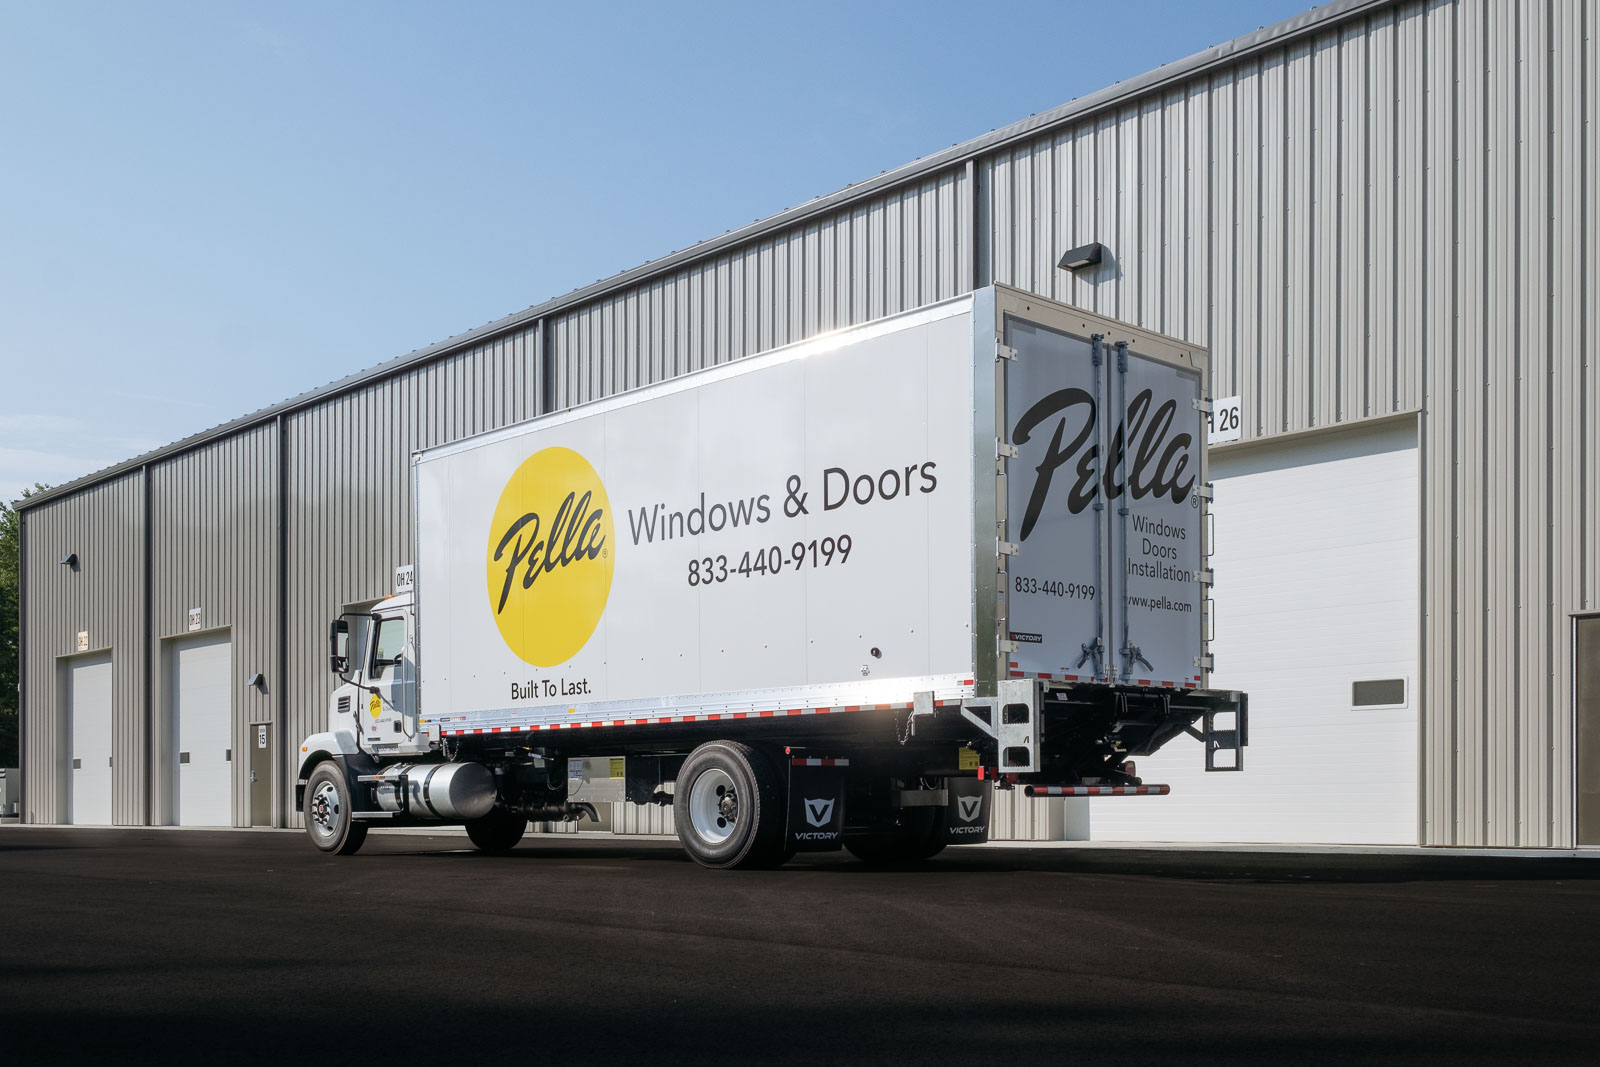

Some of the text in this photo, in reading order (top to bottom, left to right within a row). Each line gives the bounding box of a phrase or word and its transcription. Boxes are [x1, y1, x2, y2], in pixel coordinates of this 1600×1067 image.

[1219, 406, 1239, 432] 26
[1012, 387, 1195, 541] Pella
[628, 461, 937, 546] Windows & Doors
[1132, 514, 1186, 540] Windows
[494, 490, 606, 615] Pella
[687, 534, 852, 587] 833-440-9199
[1142, 538, 1177, 560] Doors
[397, 571, 413, 587] OH 24
[1128, 557, 1191, 582] Installation
[1015, 576, 1095, 600] 833-440-9199
[1015, 634, 1042, 642] VICTORY
[511, 677, 592, 700] Built To Last.
[259, 734, 266, 745] 15
[795, 832, 838, 840] VICTORY
[949, 825, 985, 835] VICTORY
